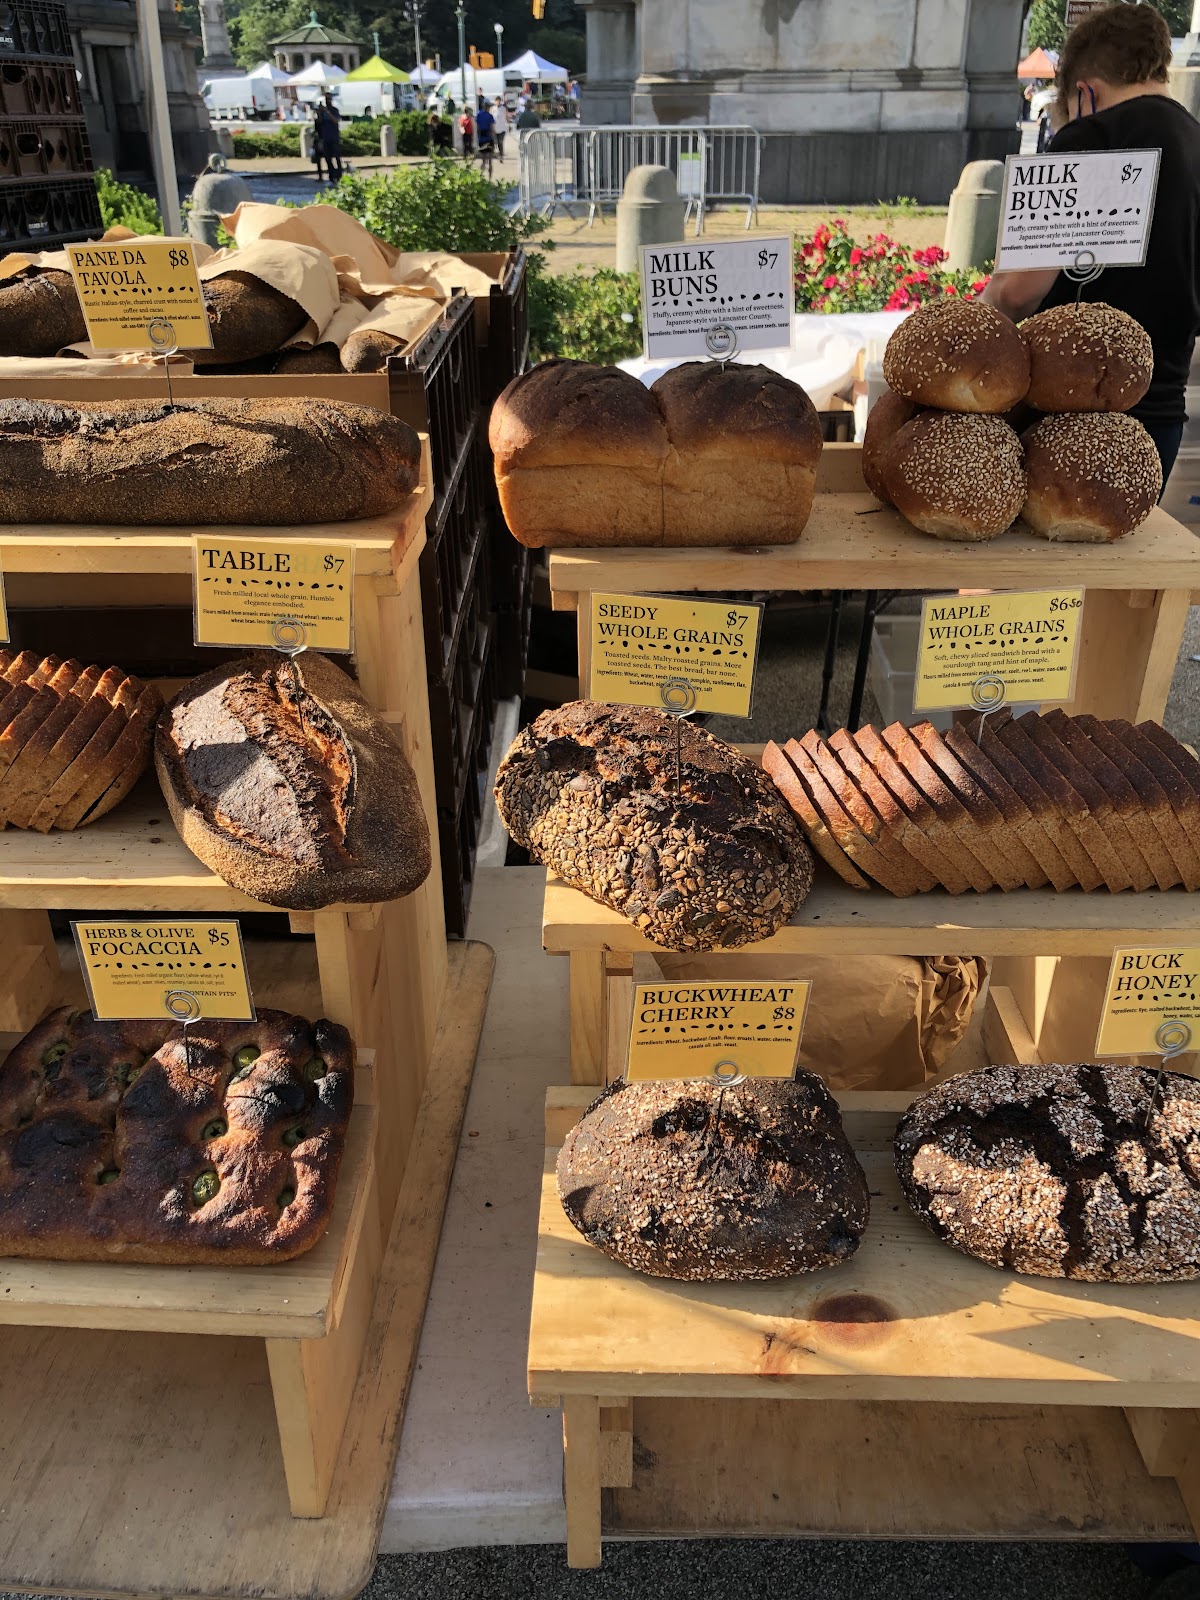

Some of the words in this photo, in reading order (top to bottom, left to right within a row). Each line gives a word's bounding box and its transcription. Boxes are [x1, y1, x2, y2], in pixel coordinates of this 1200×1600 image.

[1013, 163, 1080, 186] MILK
[1121, 162, 1143, 184] $7
[1010, 188, 1078, 211] BUNS
[1018, 232, 1060, 241] Japanese-style
[74, 251, 118, 266] PANE
[122, 250, 147, 265] DA
[168, 248, 189, 269] $8
[650, 250, 715, 274] MILK
[758, 248, 778, 269] $7
[79, 270, 147, 286] TAVOLA
[652, 274, 718, 298] BUNS
[665, 317, 707, 327] Japanese-style
[202, 549, 291, 573] TABLE
[323, 553, 345, 574] $7
[243, 599, 271, 607] elegance
[599, 604, 658, 620] SEEDY
[727, 610, 748, 630] $7
[930, 605, 990, 621] MAPLE
[598, 623, 668, 640] WHOLE
[673, 628, 744, 647] GRAINS
[928, 623, 994, 640] WHOLE
[999, 619, 1065, 635] GRAINS
[652, 655, 672, 663] Malty
[990, 649, 1020, 657] sandwich
[684, 666, 704, 674] bread,
[943, 660, 975, 668] sourdough
[1028, 656, 1049, 664] maple.
[85, 928, 127, 939] HERB
[131, 928, 142, 938] &
[146, 928, 195, 938] OLIVE
[208, 927, 230, 946] $5
[88, 941, 202, 956] FOCACCIA
[1120, 953, 1184, 970] BUCK
[1115, 974, 1198, 991] HONEY
[642, 988, 793, 1006] BUCKWHEAT
[640, 1006, 735, 1023] CHERRY
[773, 1006, 795, 1021] $8
